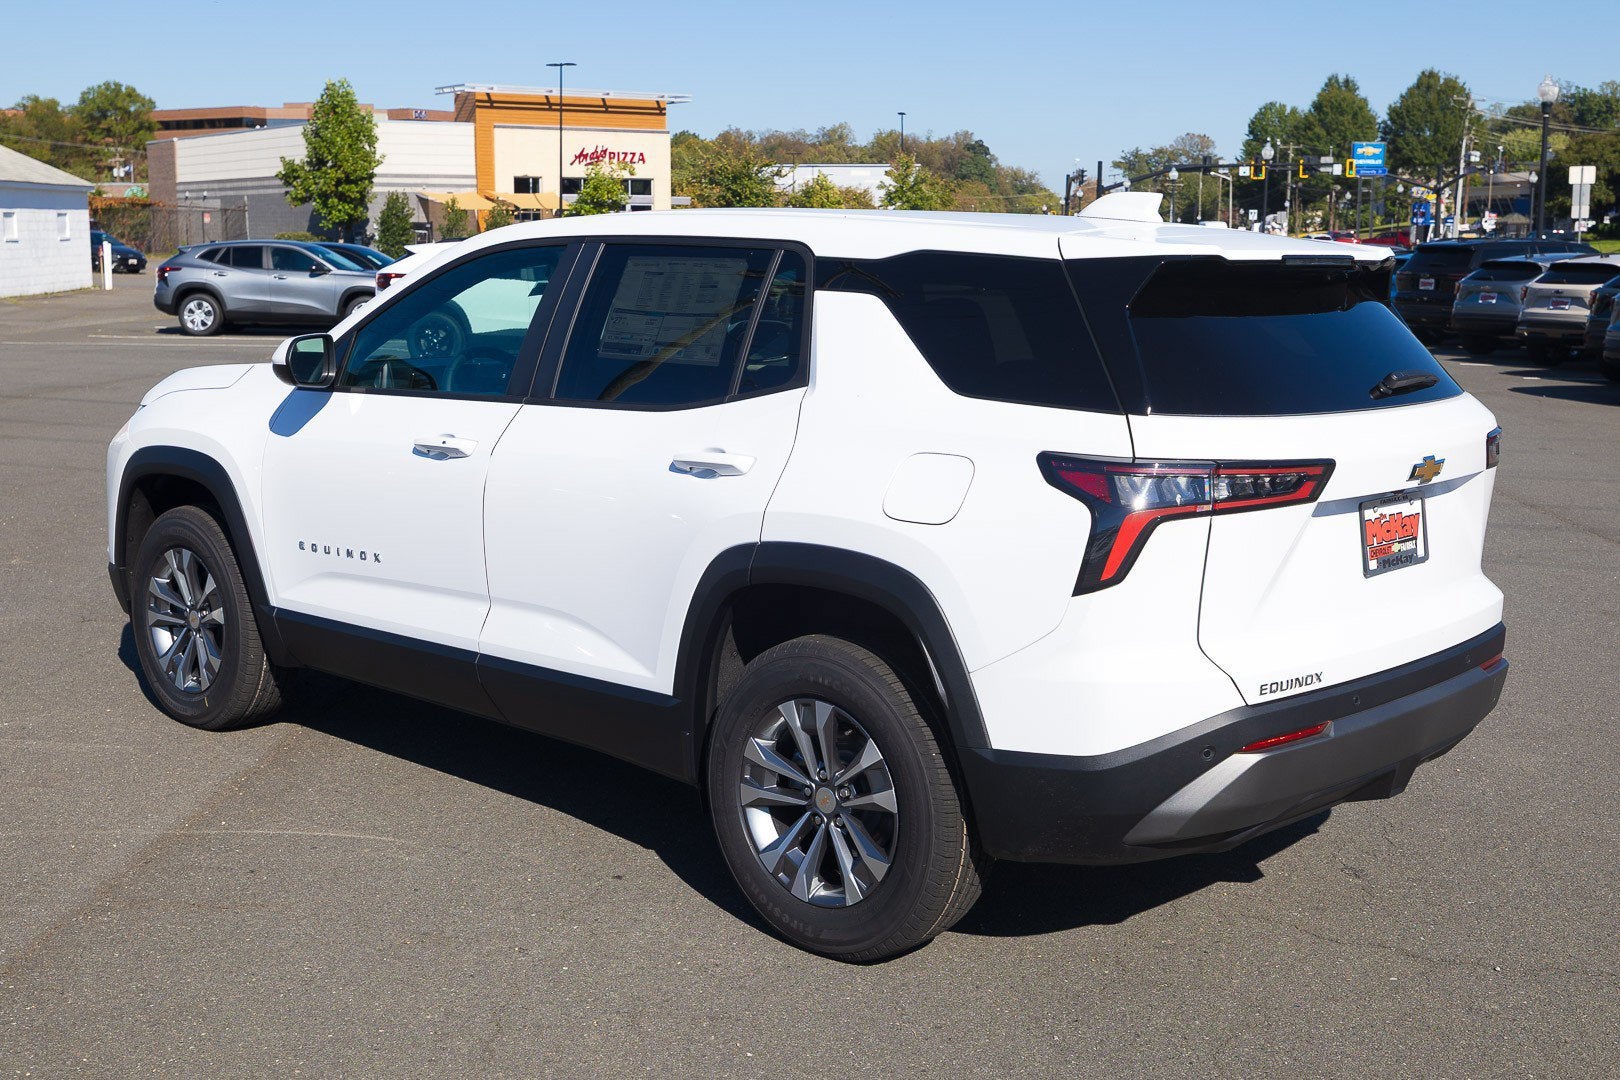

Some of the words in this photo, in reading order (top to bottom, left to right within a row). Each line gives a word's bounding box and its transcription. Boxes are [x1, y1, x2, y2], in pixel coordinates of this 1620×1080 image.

[608, 152, 646, 164] PIZZA
[1365, 512, 1420, 546] McKay
[298, 540, 381, 564] EQUINOX
[1382, 553, 1414, 569] McKay
[1259, 671, 1323, 696] EQUINOX
